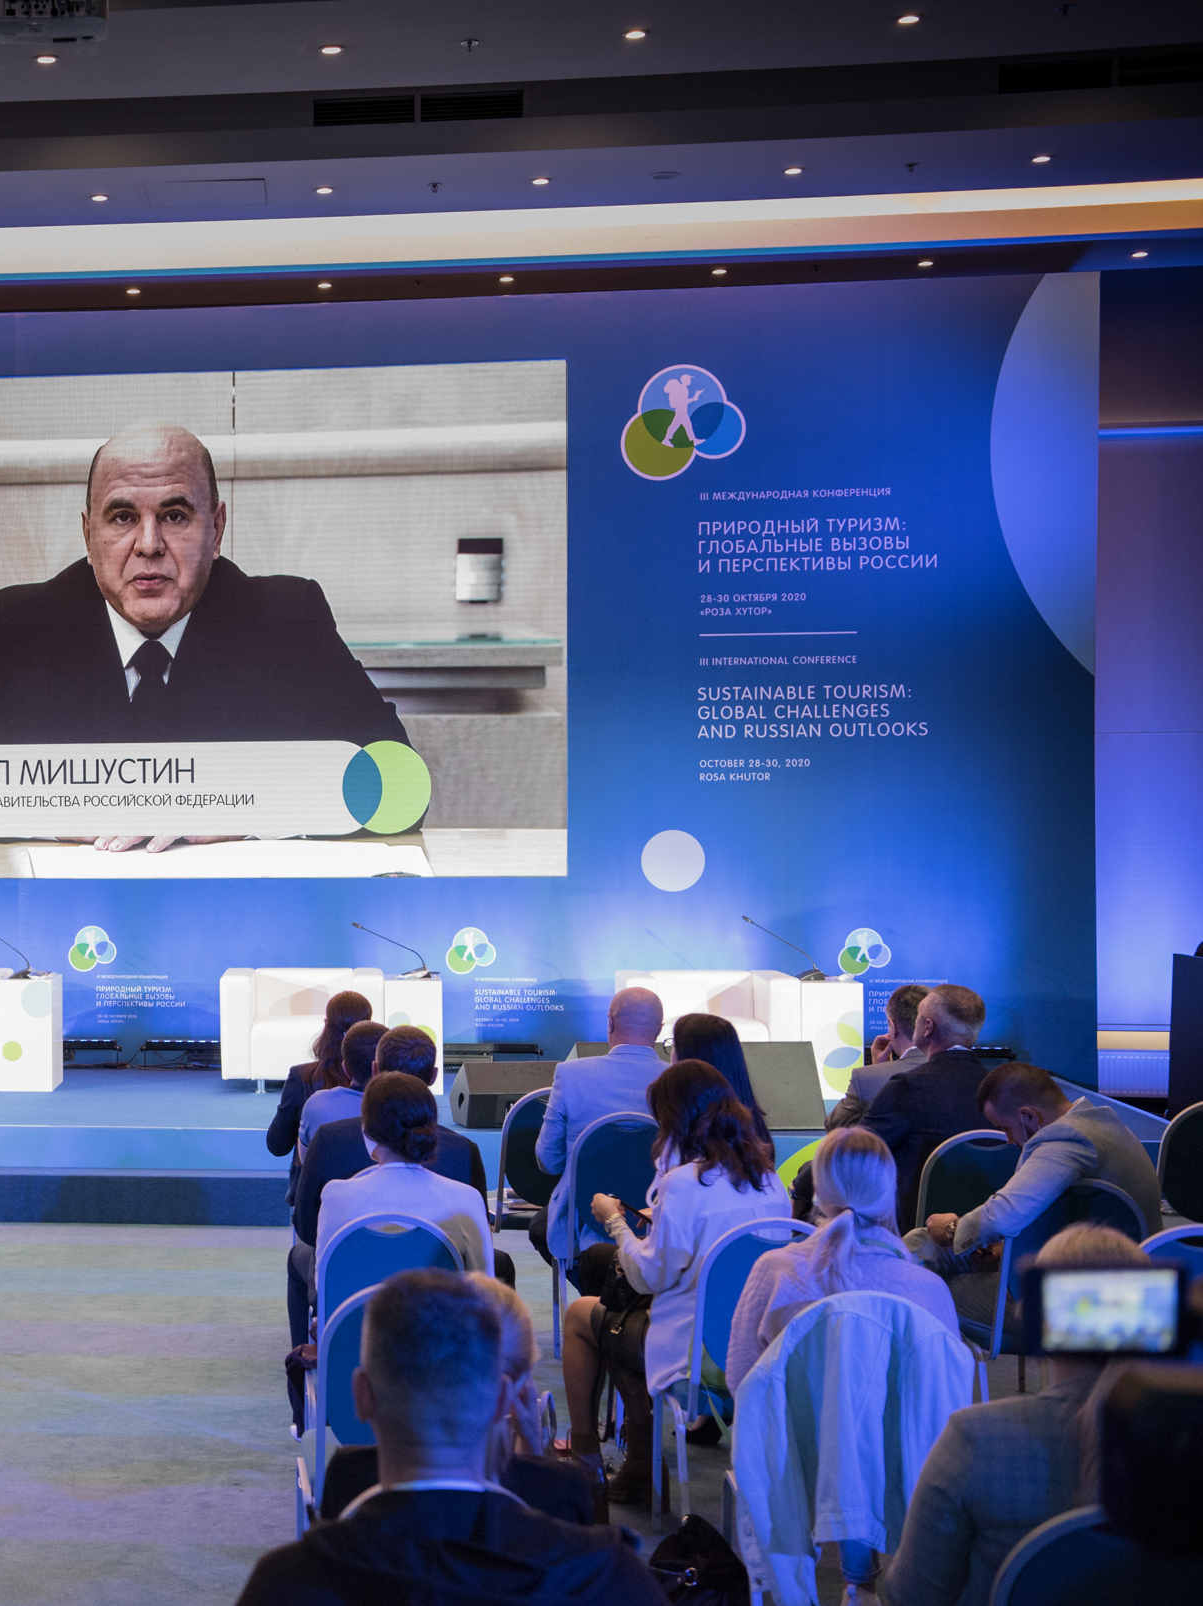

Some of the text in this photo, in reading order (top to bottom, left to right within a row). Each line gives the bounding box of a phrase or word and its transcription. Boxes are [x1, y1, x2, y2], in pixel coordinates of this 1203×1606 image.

[712, 489, 809, 501] МЕЖДУНАРОДНАЯ
[812, 487, 891, 499] КОНФЕРЕНЦИЯ
[698, 517, 907, 537] ПРИРОДНЫЙ ТУРИЗМ:
[698, 535, 910, 555] ГЛОБАЛЬНЫЕ ВЫЗОВЫ
[698, 554, 938, 574] И ПЕРСПЕКТИВЫ РОССИИ
[699, 592, 807, 603] 28-30 ОКТЯБРЯ 2020
[699, 606, 772, 617] «РОЗА ХУТОР»
[712, 656, 789, 666] INTERNATIONAL
[792, 655, 858, 665] CONFERENCE
[697, 684, 912, 701] SUSTAINABLE TOURISM:
[697, 703, 890, 720] GLOBAL CHALLENGES
[697, 721, 929, 739] AND RUSSIAN OUTLOOKS
[20, 757, 195, 786] МИШУСТИН
[699, 758, 811, 769] OCTOBER 28-30, 2020
[699, 772, 771, 782] ROSA KHUTOR
[84, 793, 171, 808] РОССИЙСКОЙ
[175, 793, 254, 809] ФЕДЕРАЦИИ
